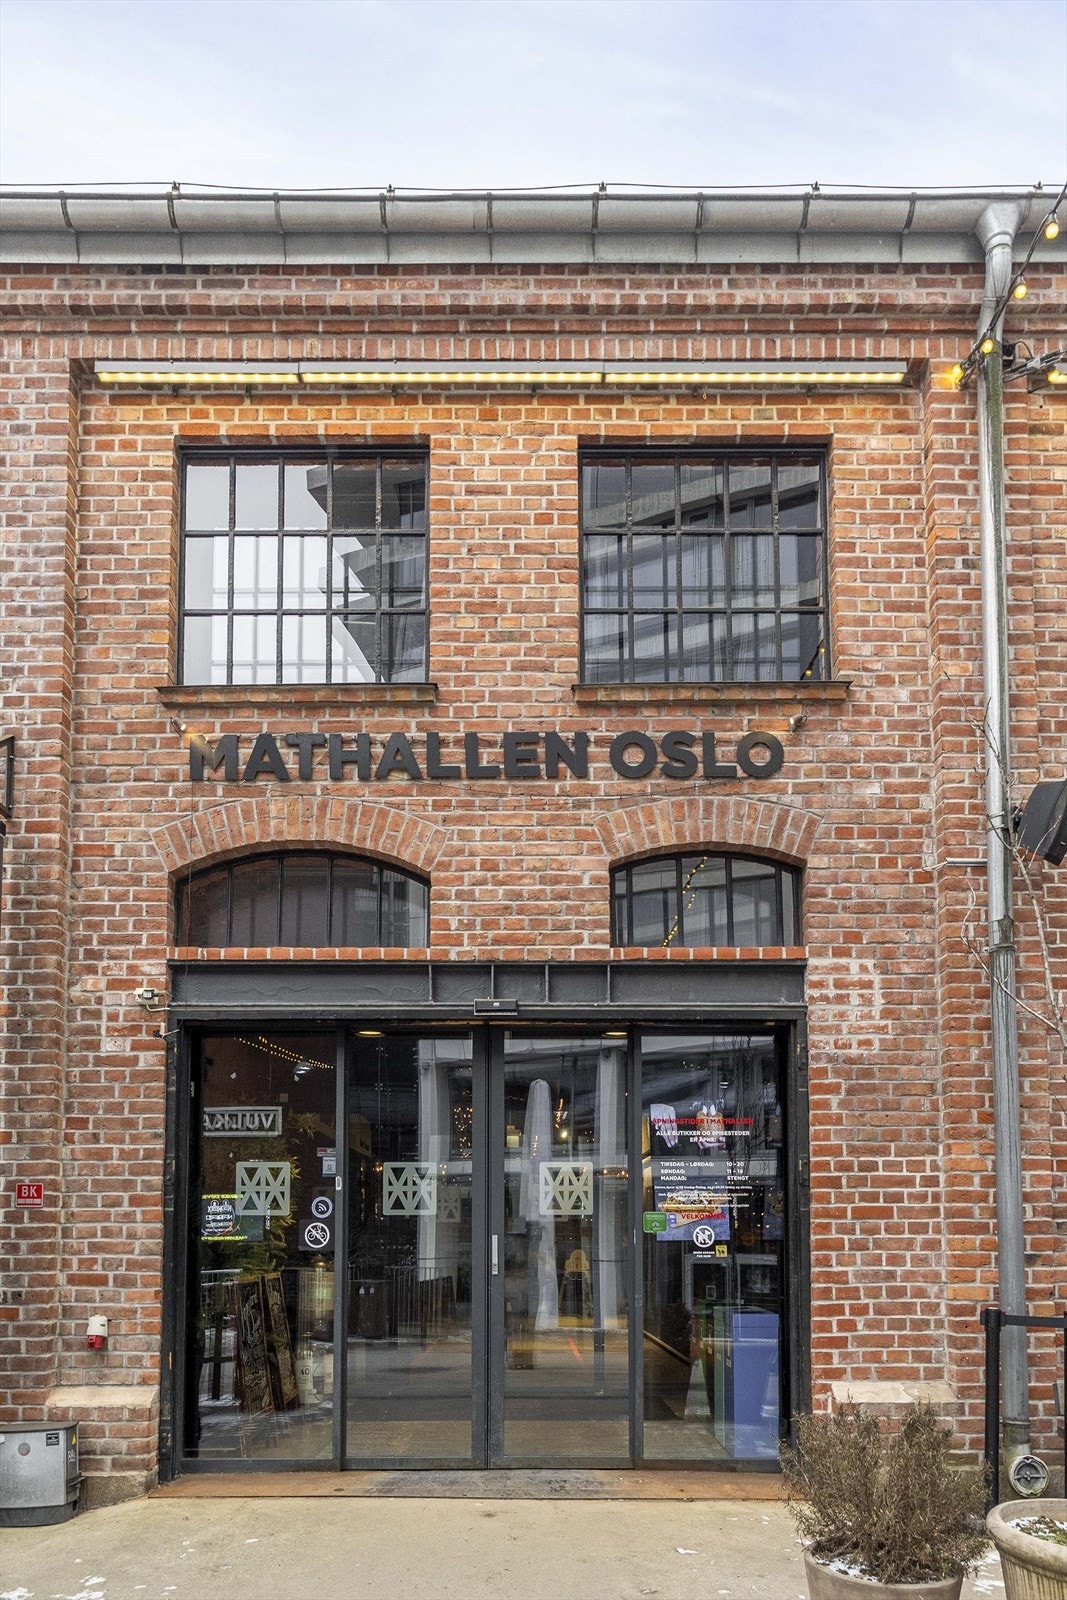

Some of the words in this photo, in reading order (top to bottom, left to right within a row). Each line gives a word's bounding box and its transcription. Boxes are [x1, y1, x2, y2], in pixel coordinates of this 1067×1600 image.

[189, 731, 588, 781] MATHALLEN
[608, 730, 785, 779] OSLO
[710, 1117, 754, 1125] MATHALLEN
[21, 1185, 38, 1197] BK
